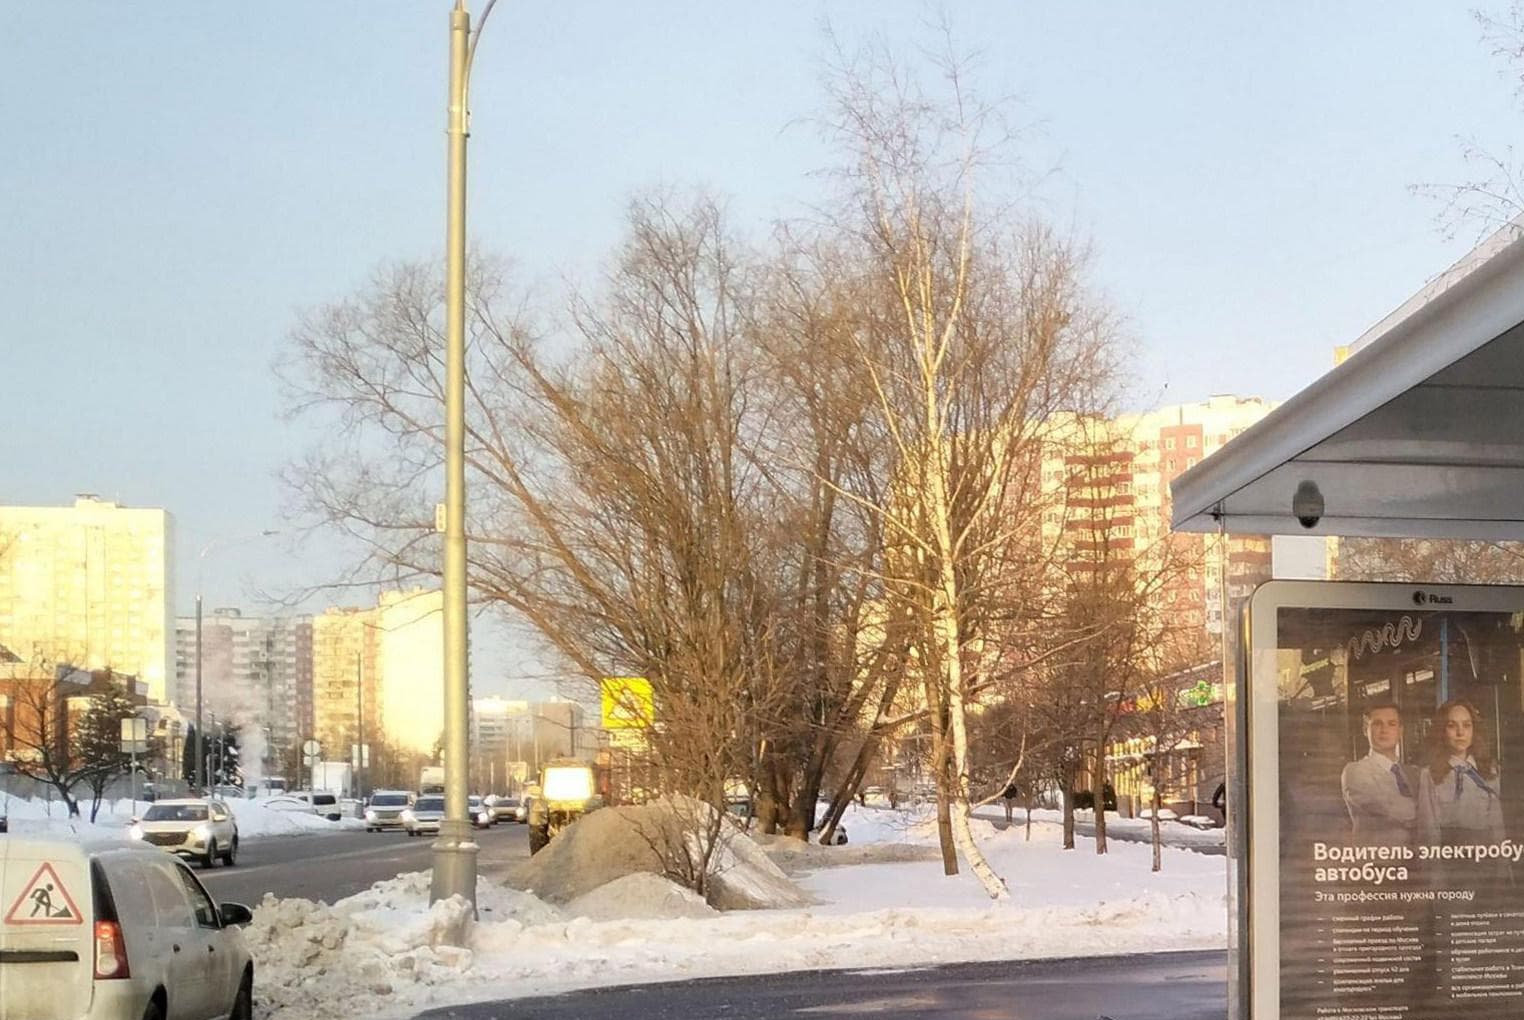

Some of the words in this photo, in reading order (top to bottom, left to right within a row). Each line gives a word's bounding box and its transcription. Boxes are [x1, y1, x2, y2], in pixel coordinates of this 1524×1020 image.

[1314, 843, 1414, 863] Водитель
[1314, 863, 1409, 885] автобуса
[1315, 891, 1335, 901] Эта
[1336, 889, 1398, 903] профессия
[1400, 891, 1435, 902] нужна
[1437, 889, 1475, 902] городу
